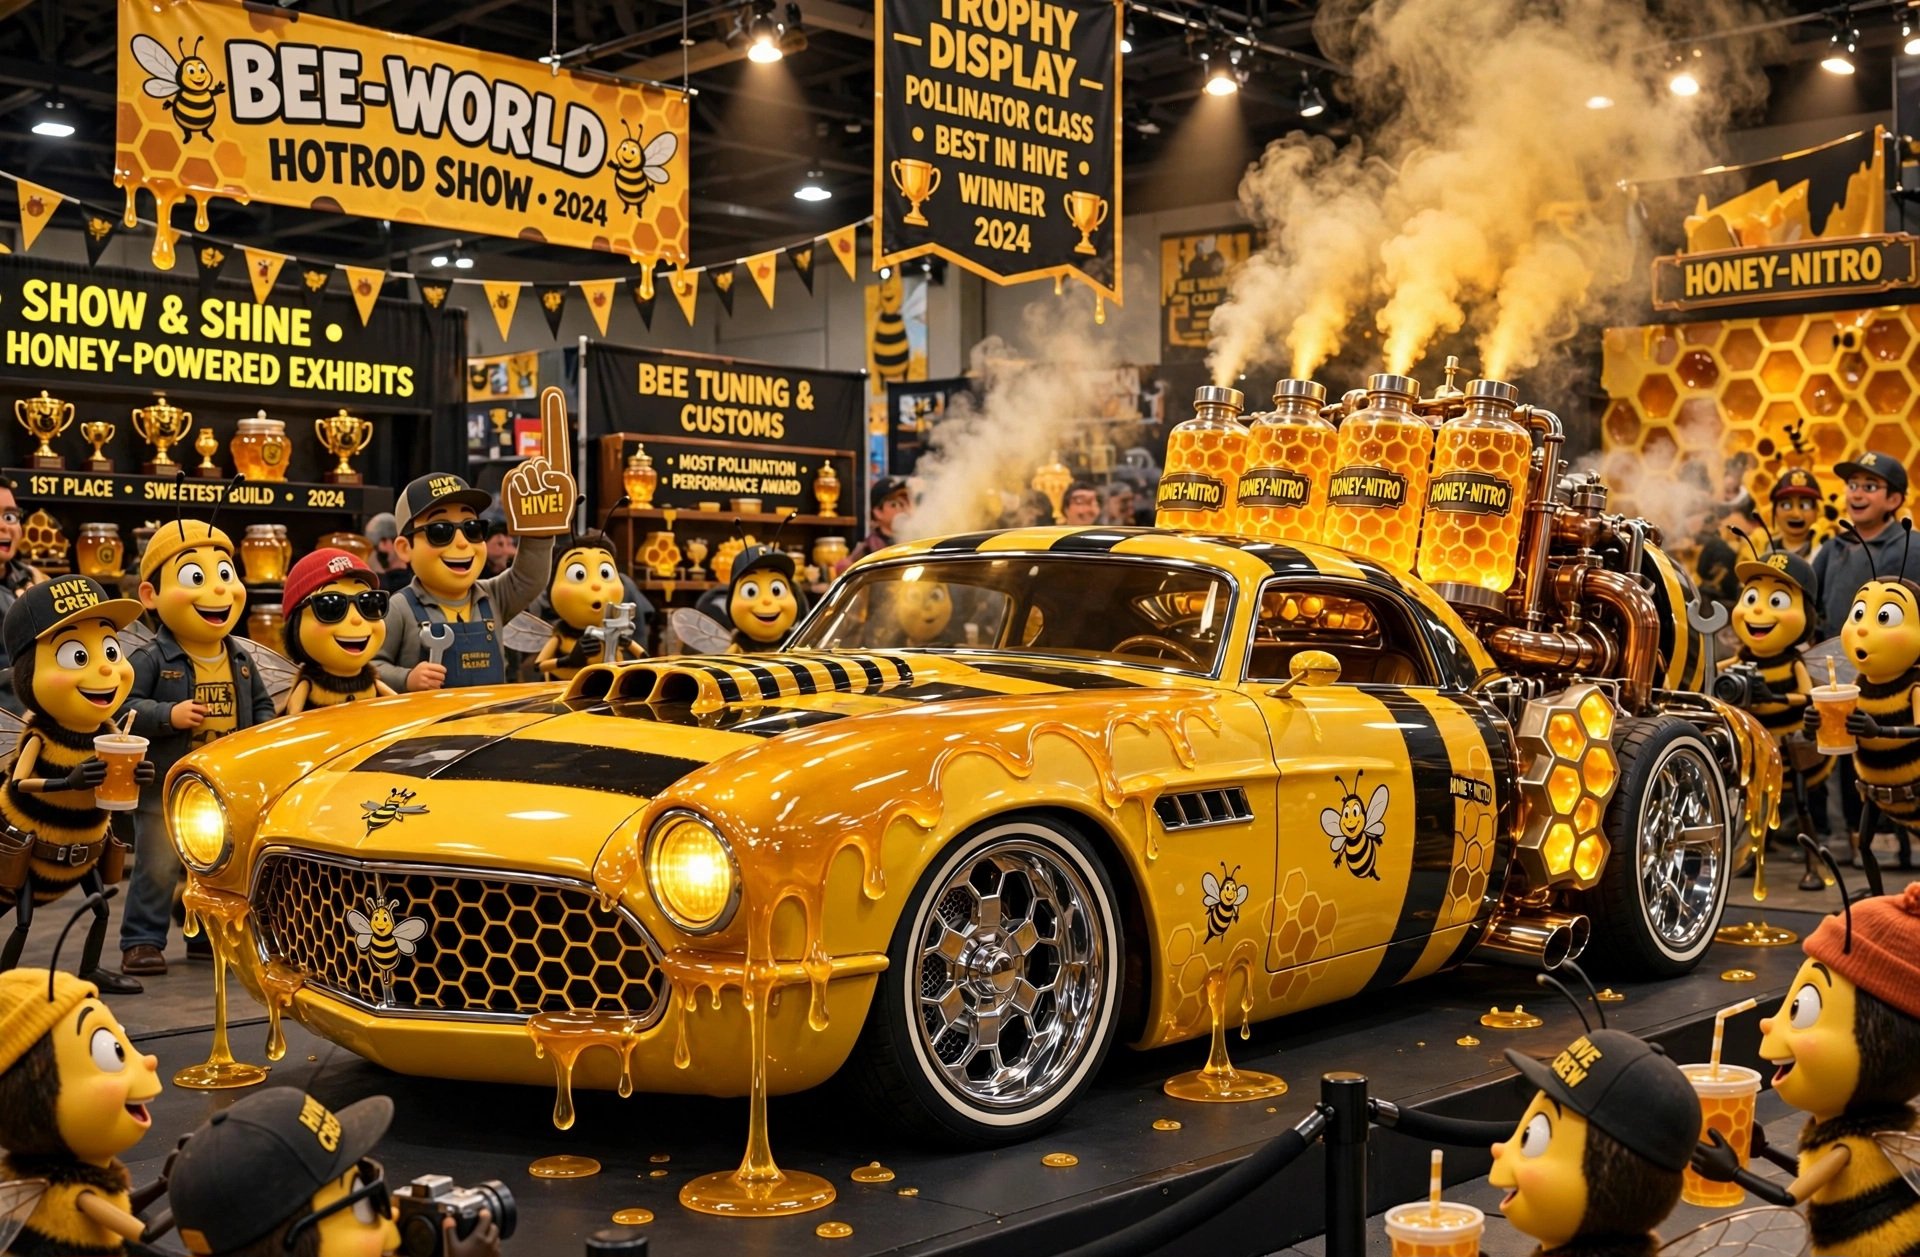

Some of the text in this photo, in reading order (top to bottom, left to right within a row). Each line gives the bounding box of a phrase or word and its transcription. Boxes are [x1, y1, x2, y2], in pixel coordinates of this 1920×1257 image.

[929, 22, 1077, 98] DISPLAY
[227, 42, 607, 176] BEE-WORLD
[905, 74, 1094, 144] POLLINATOR CLASS
[935, 124, 1068, 180] BEST IN HIVE
[269, 138, 608, 227] HOTROD SHOW 2024
[958, 172, 1046, 218] WINNER
[974, 216, 1031, 254] 2024
[1685, 246, 1882, 296] HONEY-NITRO
[21, 279, 312, 347] SHOW & SHINE
[6, 330, 414, 397] HONEY-POWERED EXHIBITS
[638, 362, 814, 411] BEE TUNING &
[680, 403, 785, 439] CUSTOMS
[679, 454, 796, 476] MOST POLLINATION
[30, 476, 345, 507] 1ST PLACE SWEETEST BUILD 2024
[672, 473, 801, 496] PERFORMANCE AWARD
[1239, 477, 1304, 500] HONEY-NITRO
[1330, 477, 1400, 500] HONEY-NITRO
[1430, 481, 1506, 508] HONEY-NITRO
[521, 494, 563, 515] HIVE!
[49, 579, 91, 600] HIVE
[54, 592, 99, 614] CREW
[206, 702, 232, 716] REW
